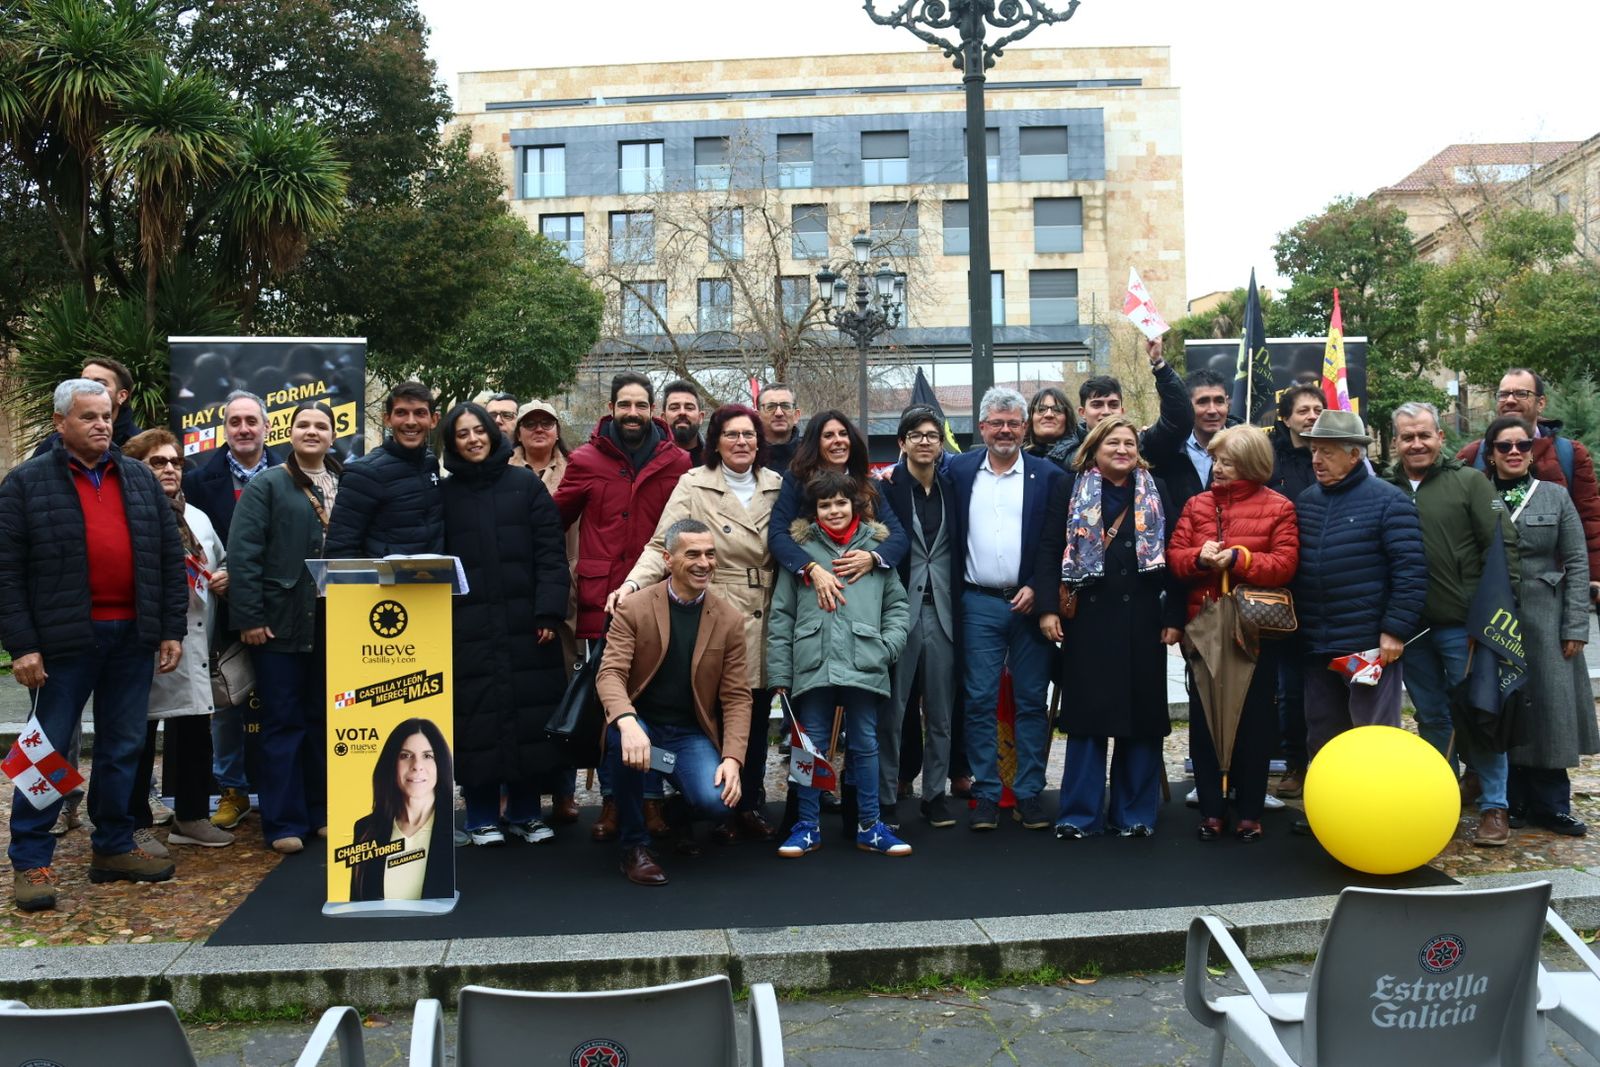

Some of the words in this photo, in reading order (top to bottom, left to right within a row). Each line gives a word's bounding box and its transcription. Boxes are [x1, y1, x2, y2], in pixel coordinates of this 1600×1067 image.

[266, 381, 327, 407] FORMA
[182, 407, 214, 430] HAY
[362, 644, 416, 656] nueve
[1483, 625, 1525, 658] Castilla
[362, 656, 390, 664] Castilla
[359, 683, 396, 699] CASTILLA
[396, 680, 402, 689] Y
[403, 674, 423, 687] LEÓN
[375, 688, 408, 704] MERECE
[408, 678, 440, 700] MÁS
[335, 728, 379, 741] VOTA
[350, 743, 377, 751] nueve
[337, 840, 378, 859] CHABELA
[349, 853, 361, 865] DE
[362, 850, 373, 861] LA
[374, 841, 402, 857] TORRE
[1370, 973, 1489, 1002] Estrella
[1371, 1000, 1477, 1029] Galicia
